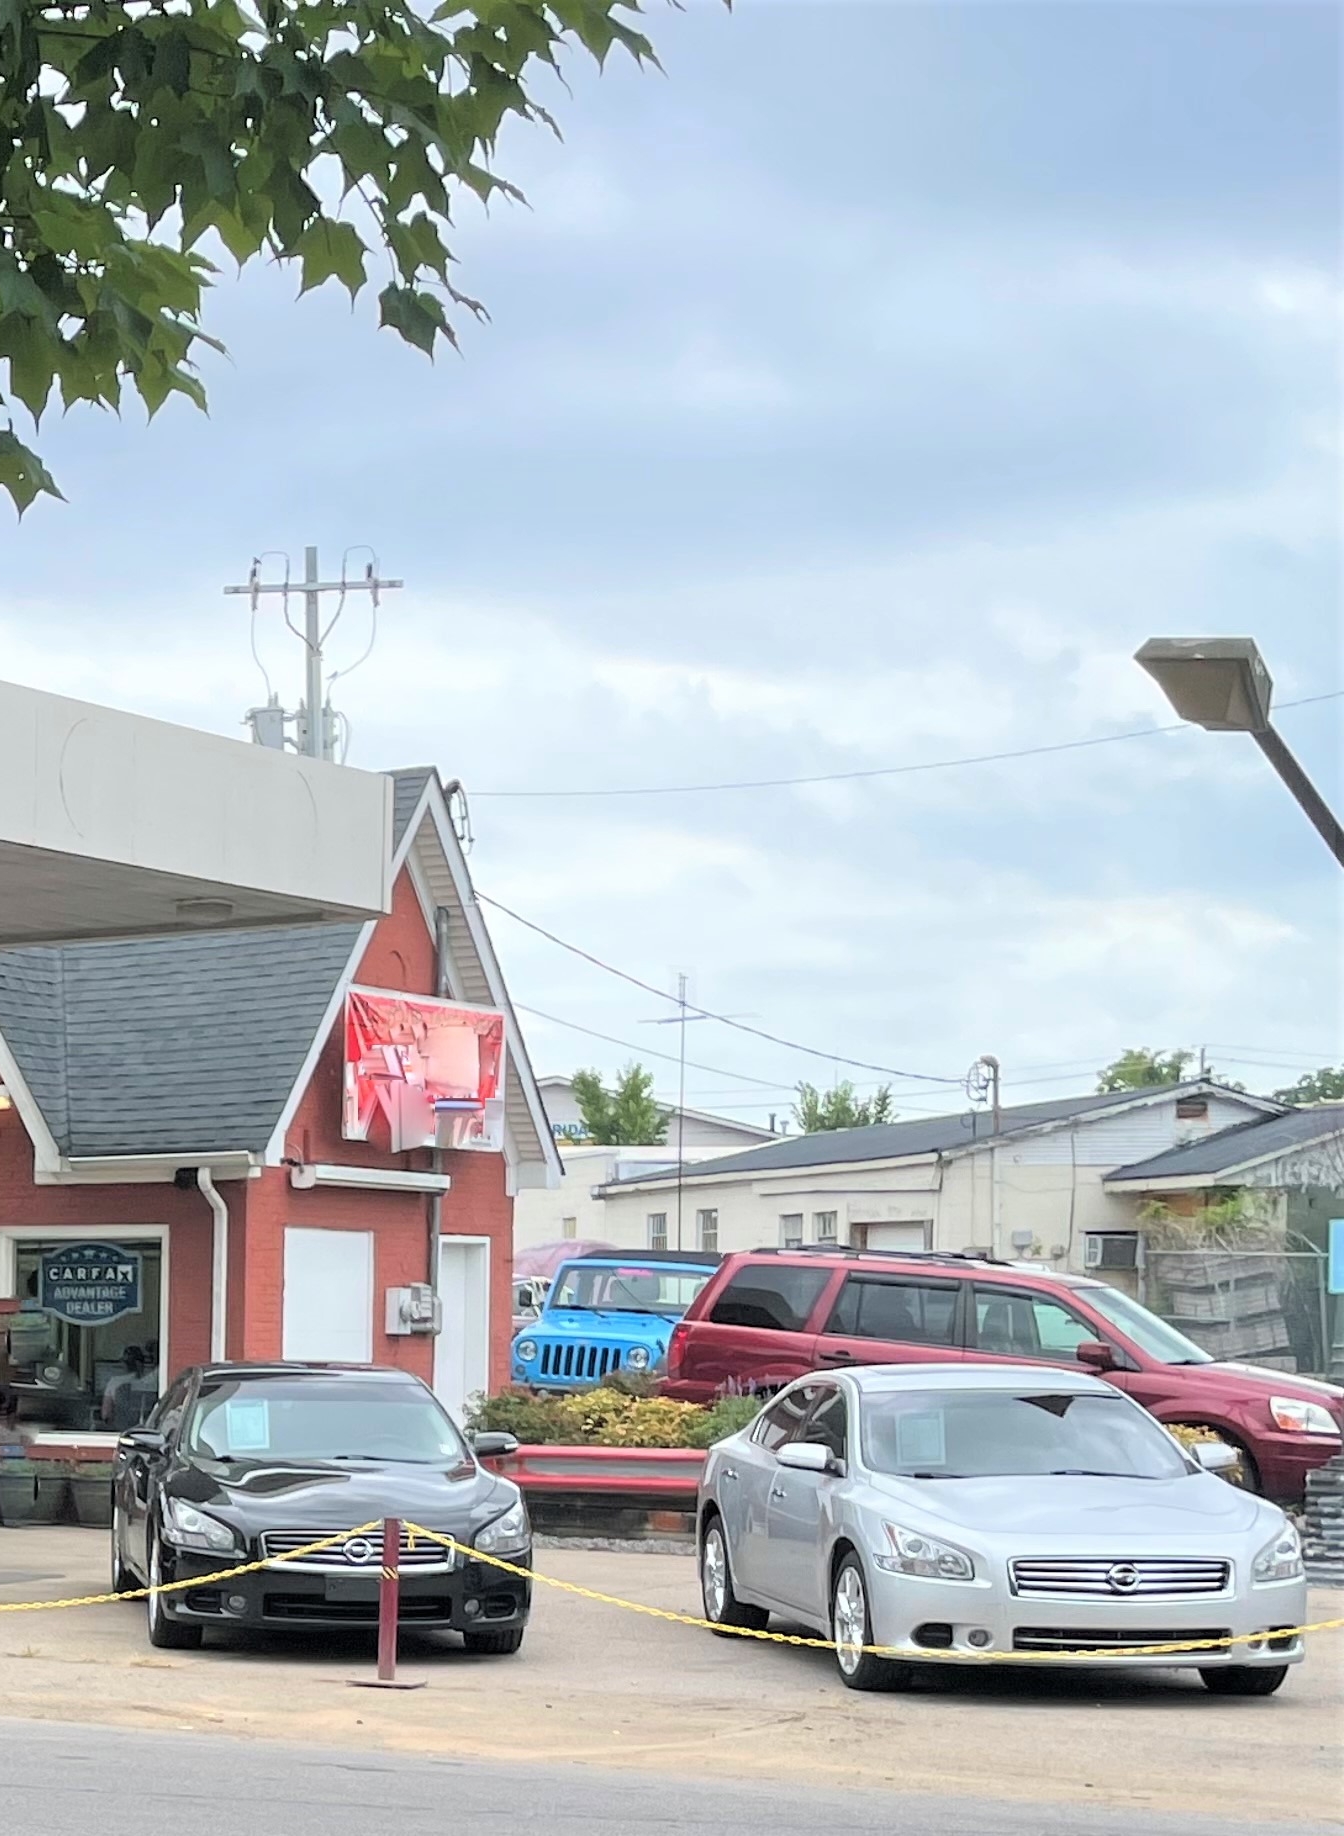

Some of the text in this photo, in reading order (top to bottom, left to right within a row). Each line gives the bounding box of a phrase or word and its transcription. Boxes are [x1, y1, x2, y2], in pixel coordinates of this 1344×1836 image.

[49, 1265, 133, 1283] CARFAX
[54, 1286, 127, 1300] ADVANTAGE
[66, 1301, 114, 1314] DEALER
